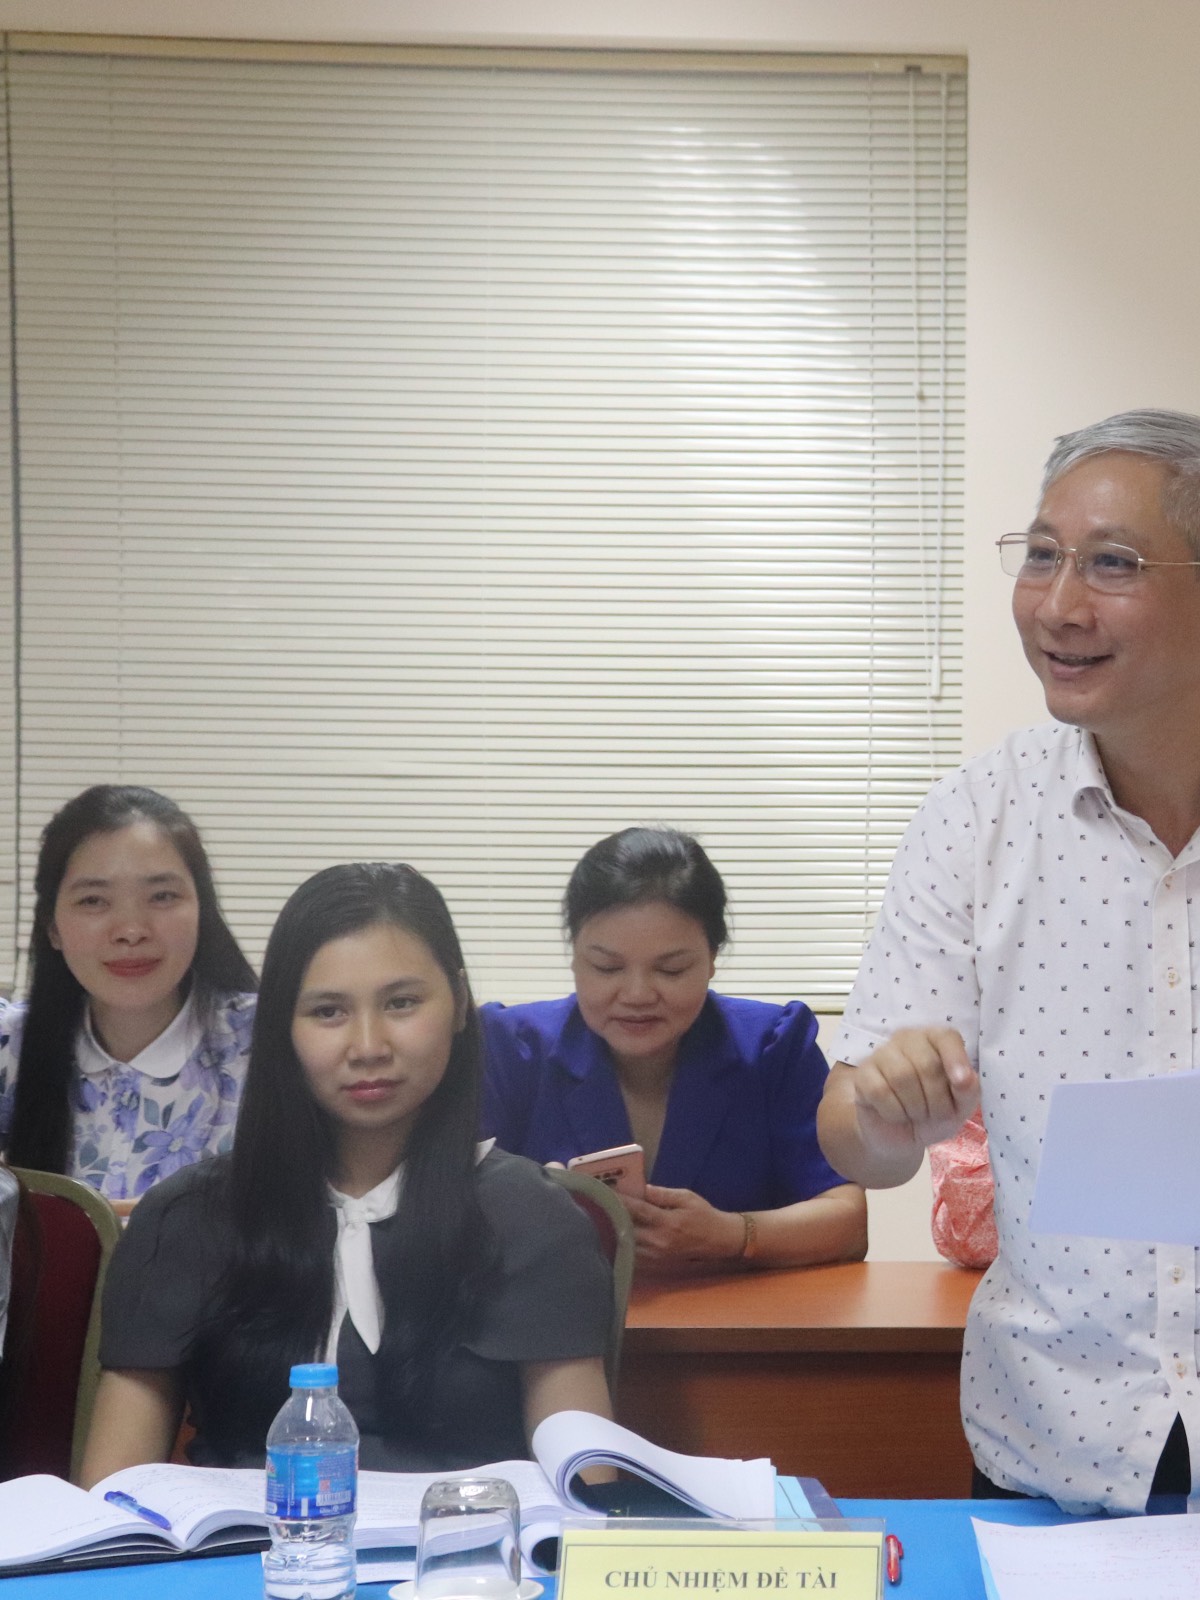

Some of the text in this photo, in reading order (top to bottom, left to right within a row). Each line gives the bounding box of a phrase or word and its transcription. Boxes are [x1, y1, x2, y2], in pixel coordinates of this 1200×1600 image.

[605, 1566, 837, 1592] CHỦ NHIỆM ĐỀ TÀI
